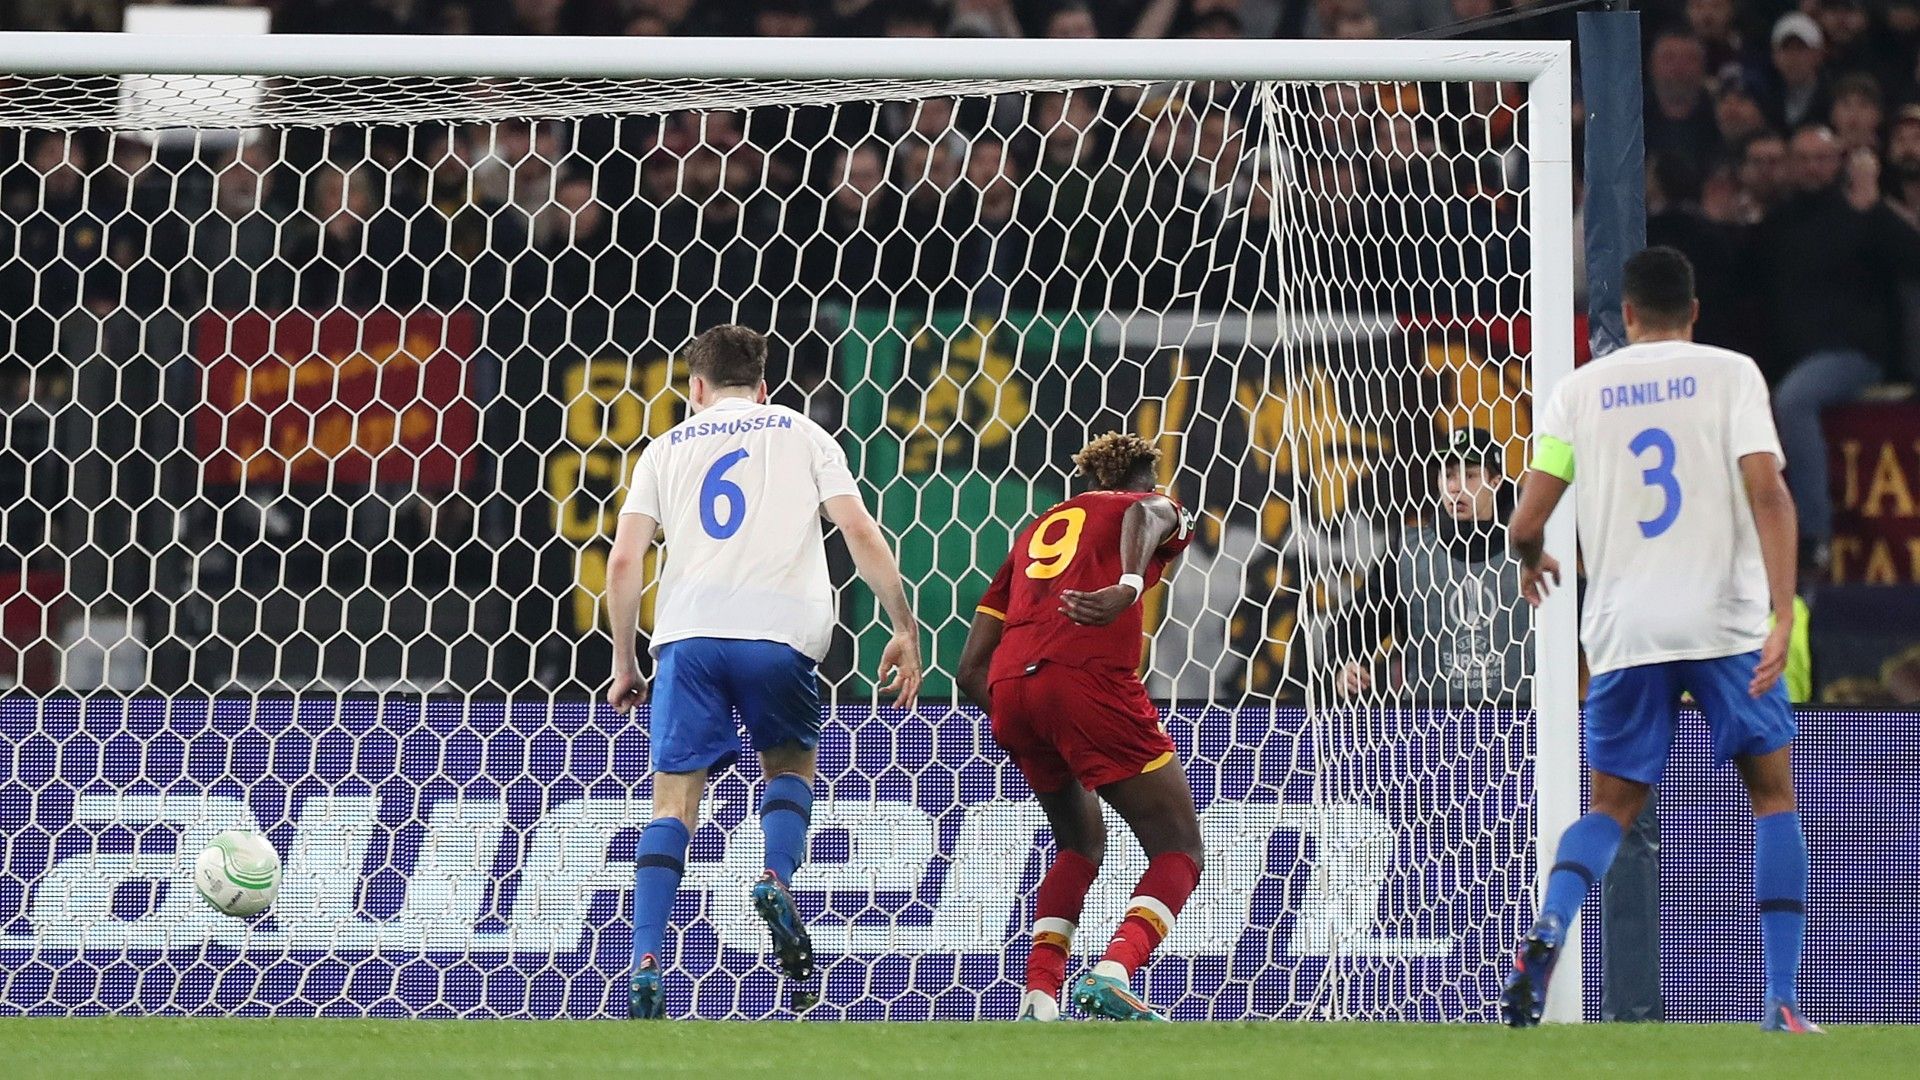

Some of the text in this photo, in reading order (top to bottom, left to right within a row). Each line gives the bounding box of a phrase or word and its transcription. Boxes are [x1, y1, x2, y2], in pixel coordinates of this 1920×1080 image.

[1601, 376, 1697, 409] DANILHO
[670, 415, 793, 446] RASMUSSEN
[700, 447, 749, 540] 6
[1629, 428, 1683, 540] 3
[1024, 507, 1086, 579] 9
[1452, 679, 1493, 690] LEGE
[0, 795, 1454, 956] aufenn
